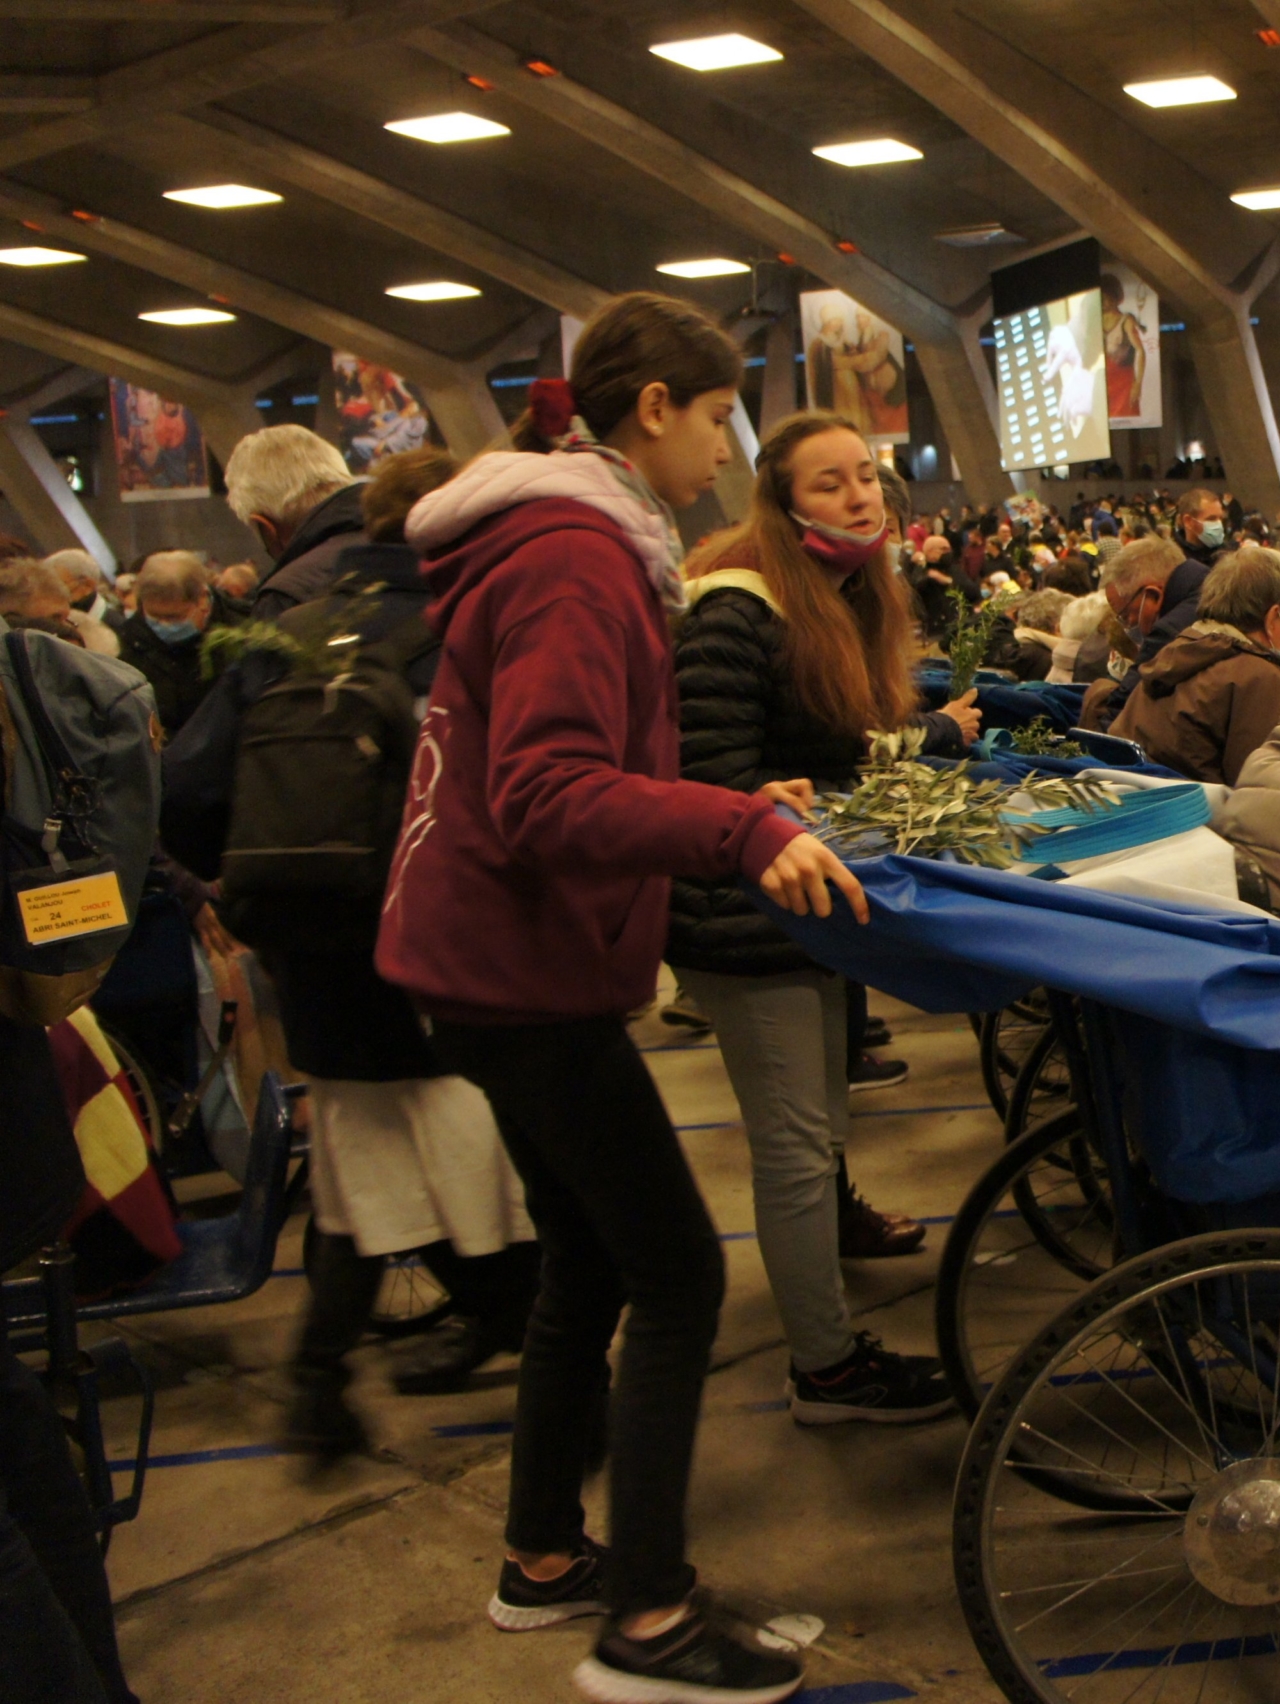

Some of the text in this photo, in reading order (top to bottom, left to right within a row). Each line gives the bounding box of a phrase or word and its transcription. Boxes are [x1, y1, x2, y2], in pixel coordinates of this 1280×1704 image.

[27, 900, 63, 910] VALANJOU
[81, 900, 112, 911] CHOLET
[49, 911, 62, 921] 24
[33, 913, 112, 934] ABRI SAINT-MICHEL
